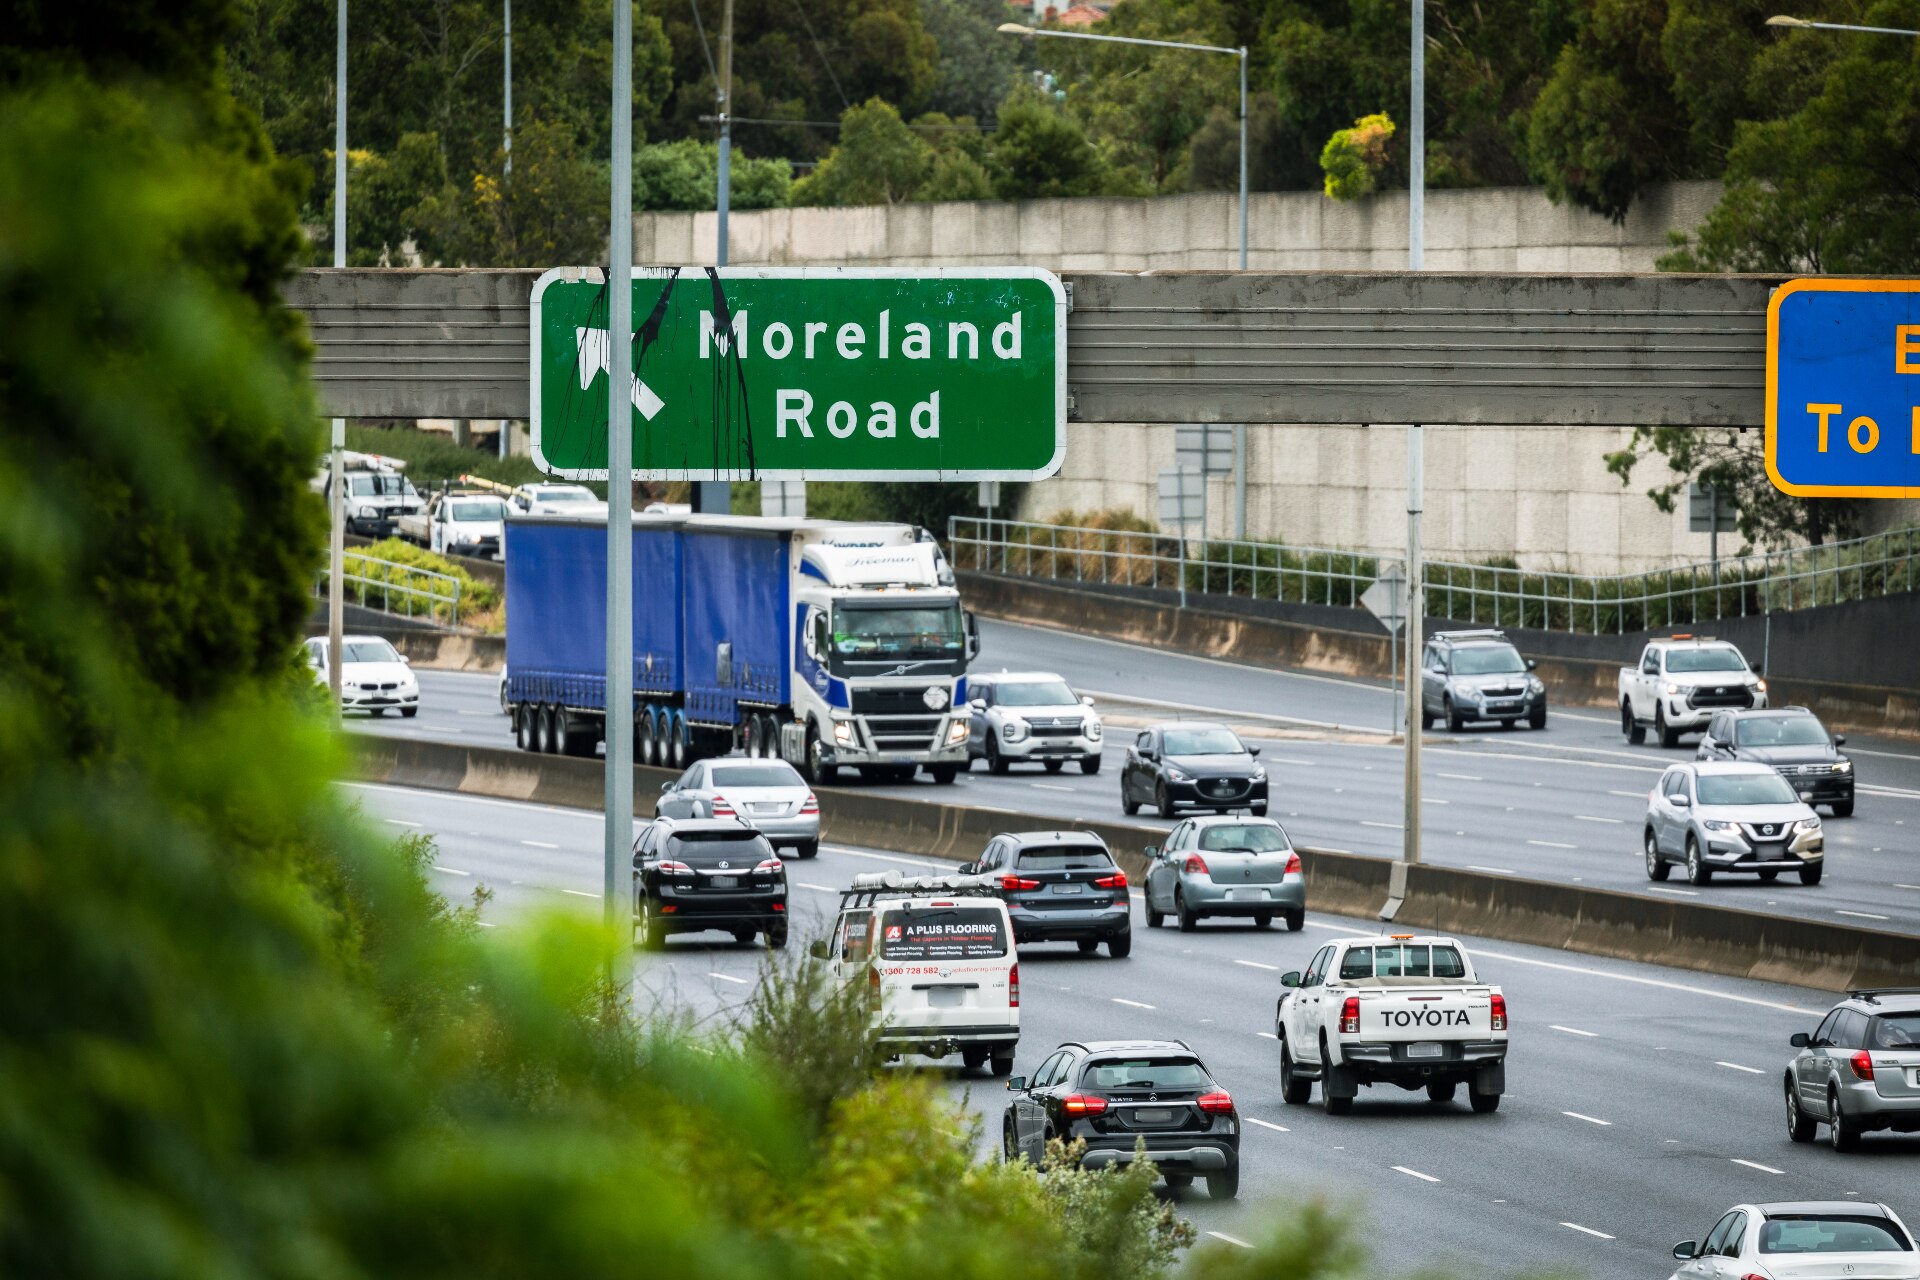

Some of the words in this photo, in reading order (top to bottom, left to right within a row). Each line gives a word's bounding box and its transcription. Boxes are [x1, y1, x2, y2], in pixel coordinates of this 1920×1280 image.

[699, 308, 1022, 360] Moreland
[776, 388, 940, 438] Road
[1806, 402, 1880, 454] To
[907, 926, 914, 935] A
[917, 925, 942, 935] PLUS
[945, 924, 997, 934] FLOORING
[884, 967, 904, 975] 1300
[923, 966, 939, 974] 582
[1380, 1009, 1471, 1027] TOYOTA
